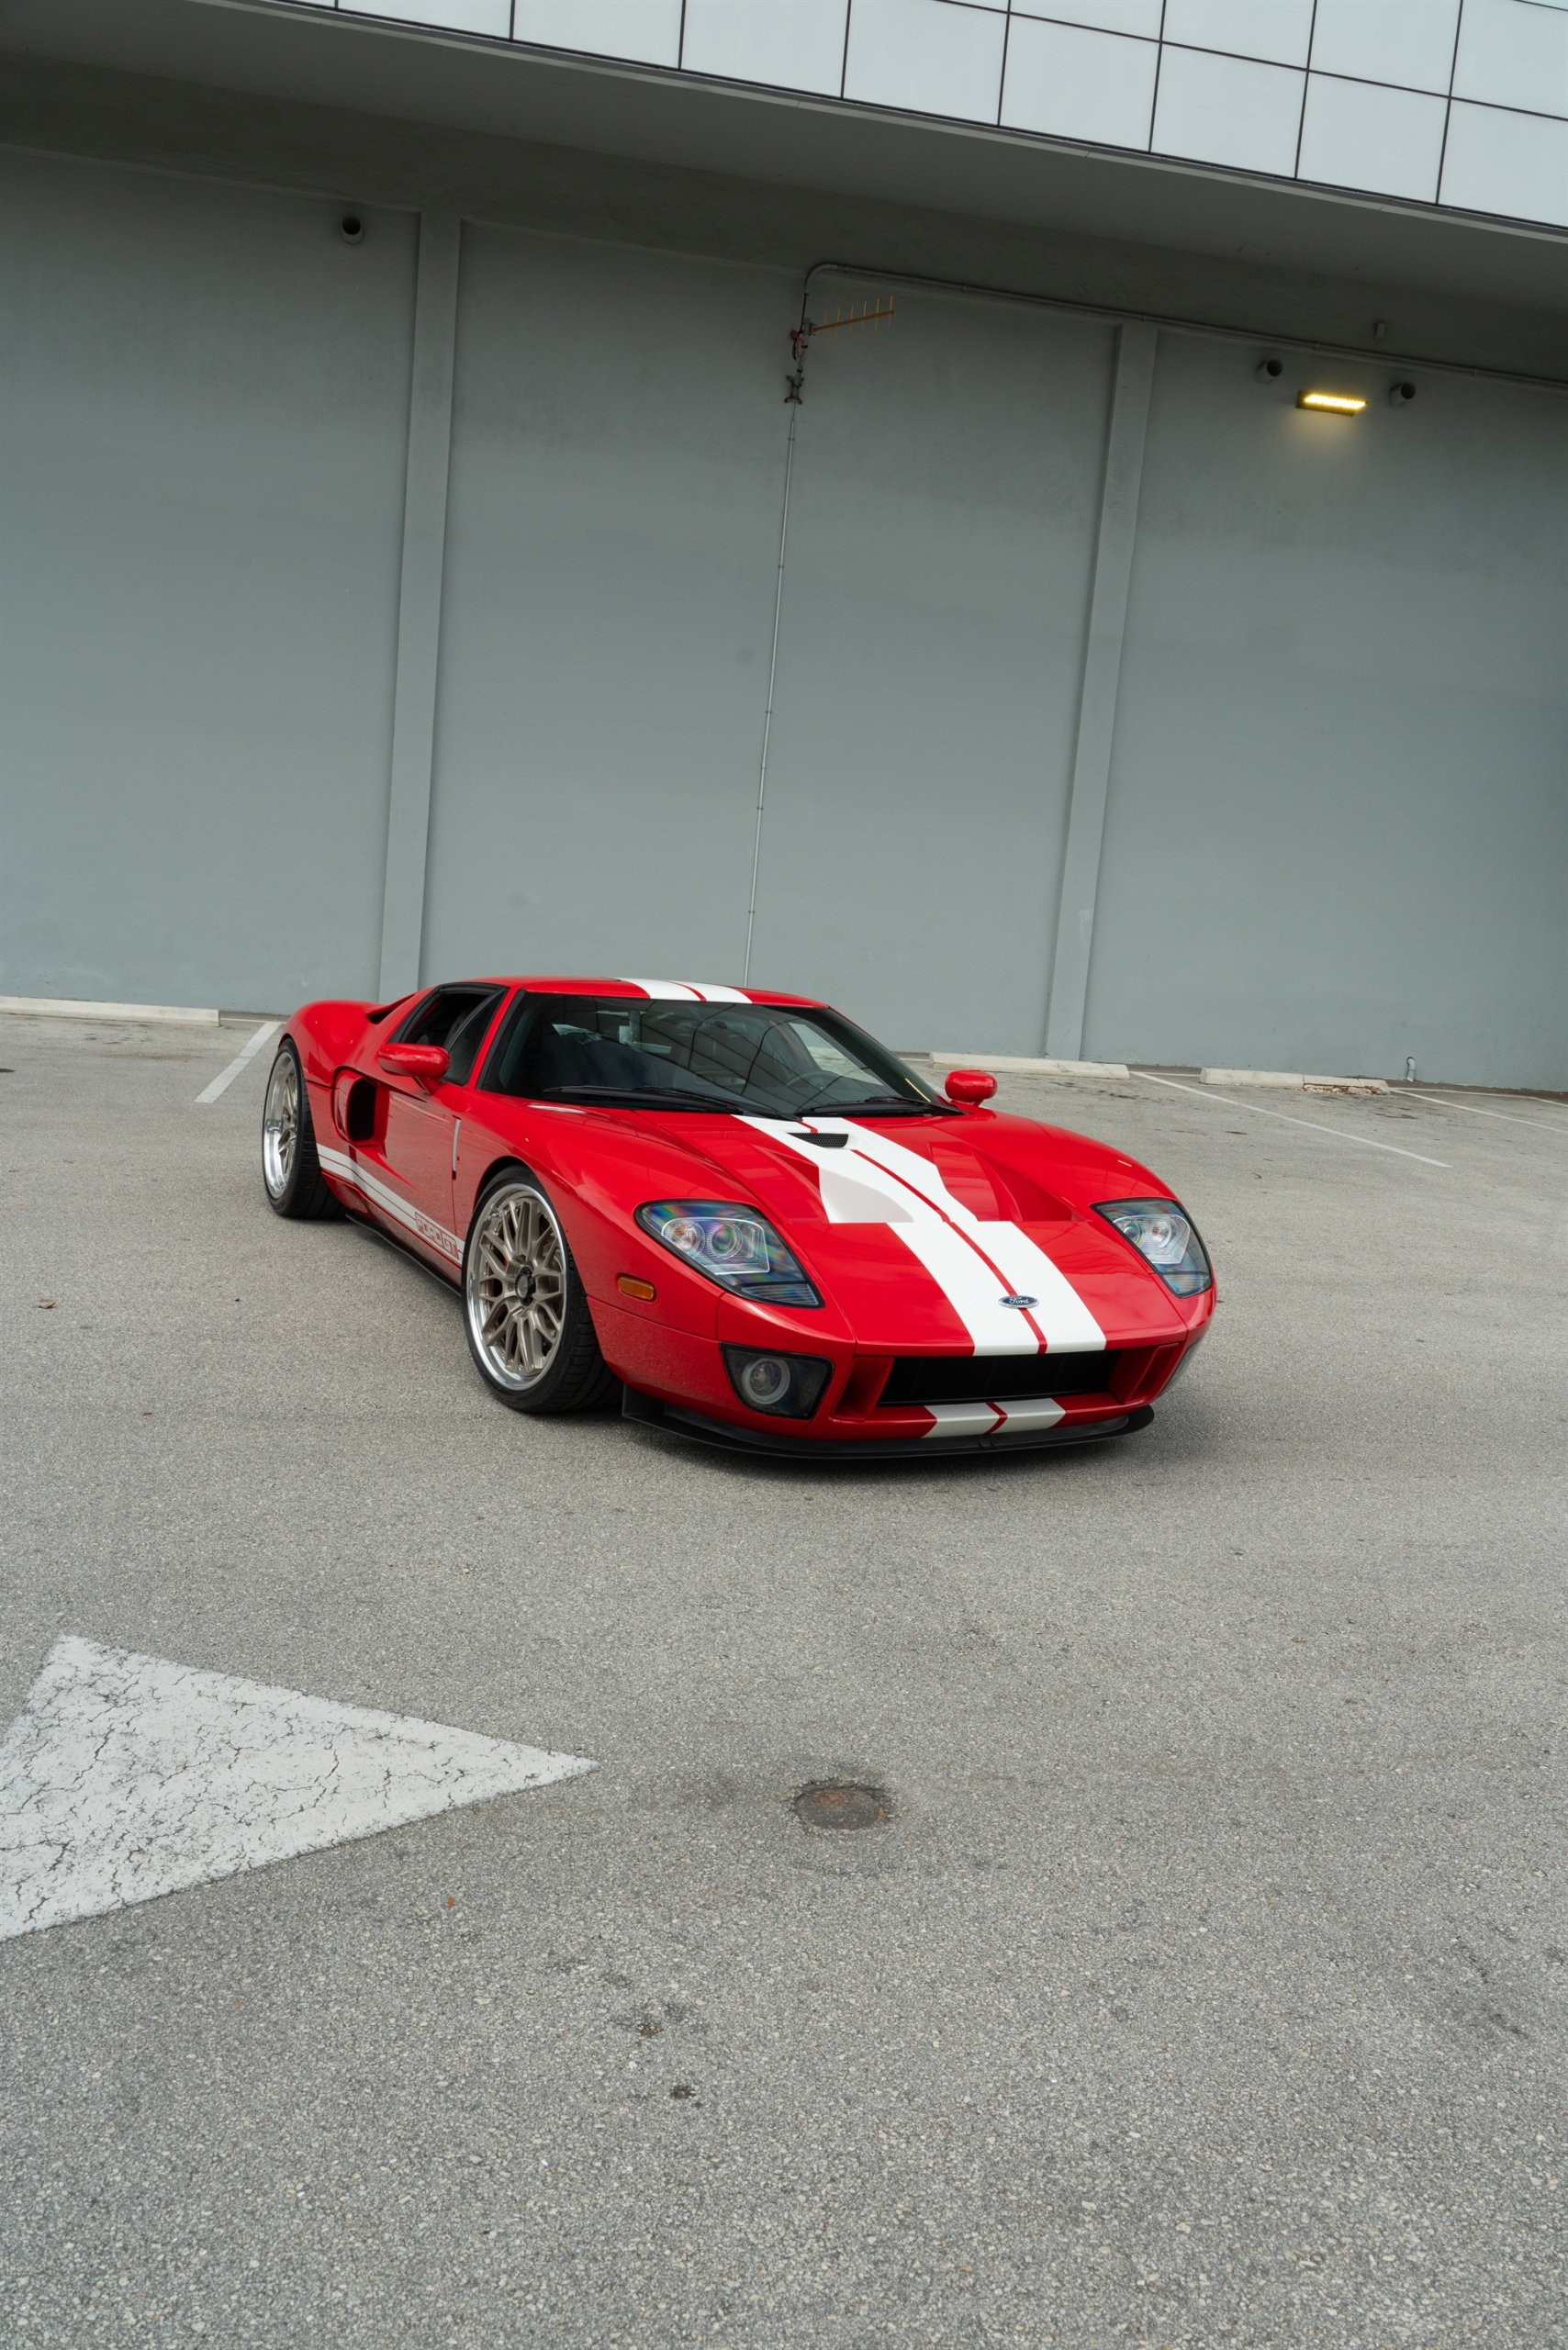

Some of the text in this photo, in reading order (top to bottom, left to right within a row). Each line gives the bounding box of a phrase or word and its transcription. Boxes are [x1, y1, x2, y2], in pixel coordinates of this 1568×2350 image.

[416, 1214, 456, 1255] FORD GT
[1009, 1296, 1029, 1304] Ford
